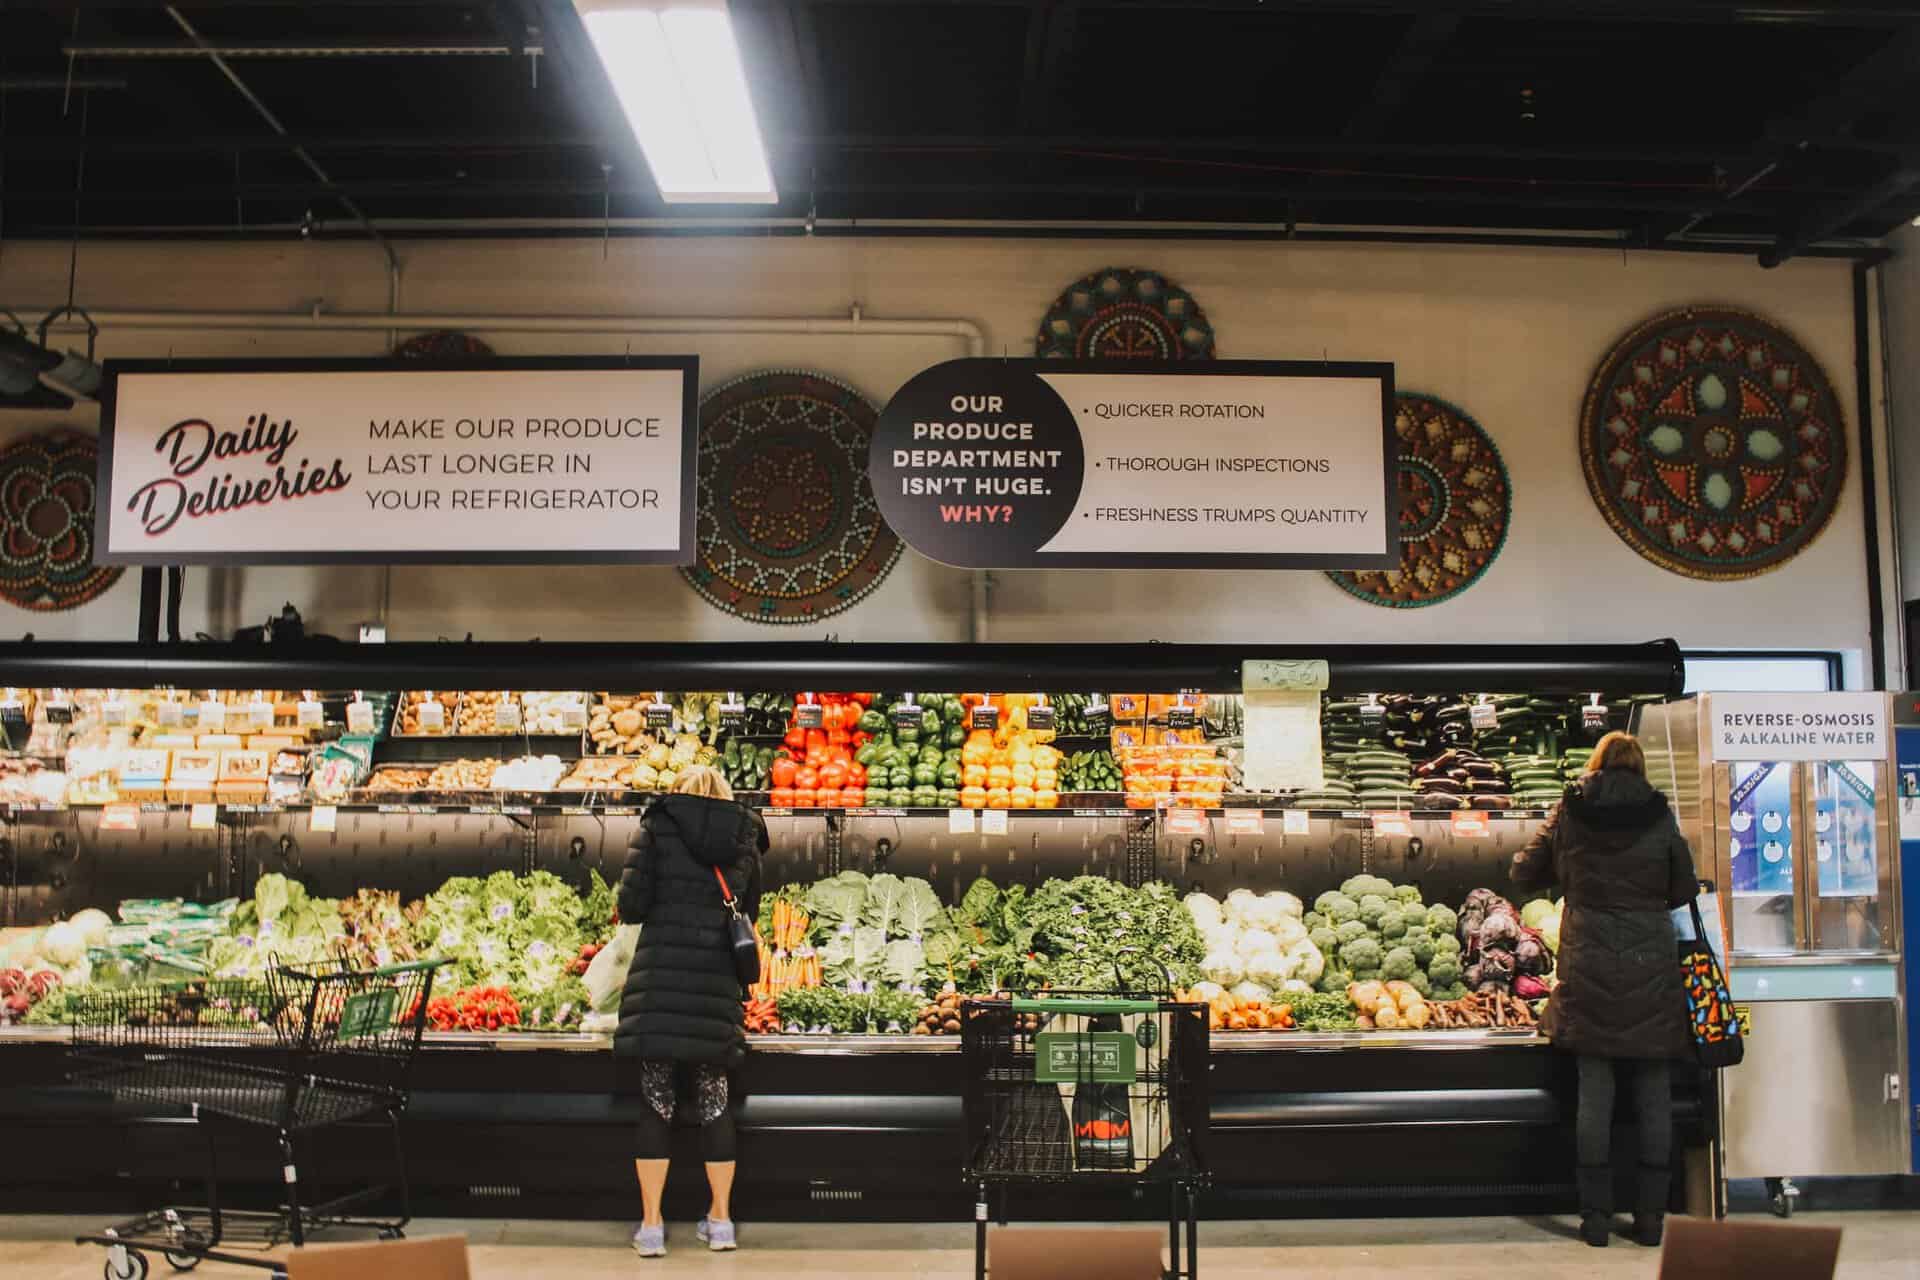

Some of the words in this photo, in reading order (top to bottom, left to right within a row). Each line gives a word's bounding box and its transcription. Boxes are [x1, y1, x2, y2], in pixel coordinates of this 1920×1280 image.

[950, 396, 1003, 413] OUR
[1095, 403, 1174, 419] QUICKER
[1180, 404, 1265, 419] ROTATION
[369, 418, 445, 439] MAKE
[455, 418, 514, 438] OUR
[526, 418, 660, 439] PRODUCE
[913, 423, 1033, 441] PRODUCE
[155, 413, 299, 478] Daily
[367, 454, 433, 475] LAST
[442, 454, 554, 475] LONGER
[565, 454, 591, 473] IN
[892, 450, 1062, 469] DEPARTMENT
[1106, 457, 1209, 472] THOROUGH
[1215, 458, 1330, 473] INSPECTIONS
[902, 477, 968, 496] ISN'T
[975, 477, 1052, 496] HUGE.
[127, 458, 352, 538] Deliveries
[365, 489, 441, 510] YOUR
[451, 489, 659, 510] REFRIGERATOR
[940, 504, 1014, 523] WHY?
[1095, 507, 1198, 522] FRESHNESS
[1203, 508, 1276, 523] TRUMPS
[1281, 509, 1369, 525] QUANTITY
[1723, 713, 1875, 727] REVERSE-OSMOSIS
[1724, 732, 1735, 745] &
[1739, 731, 1817, 745] ALKALINE
[1822, 731, 1875, 745] WATER
